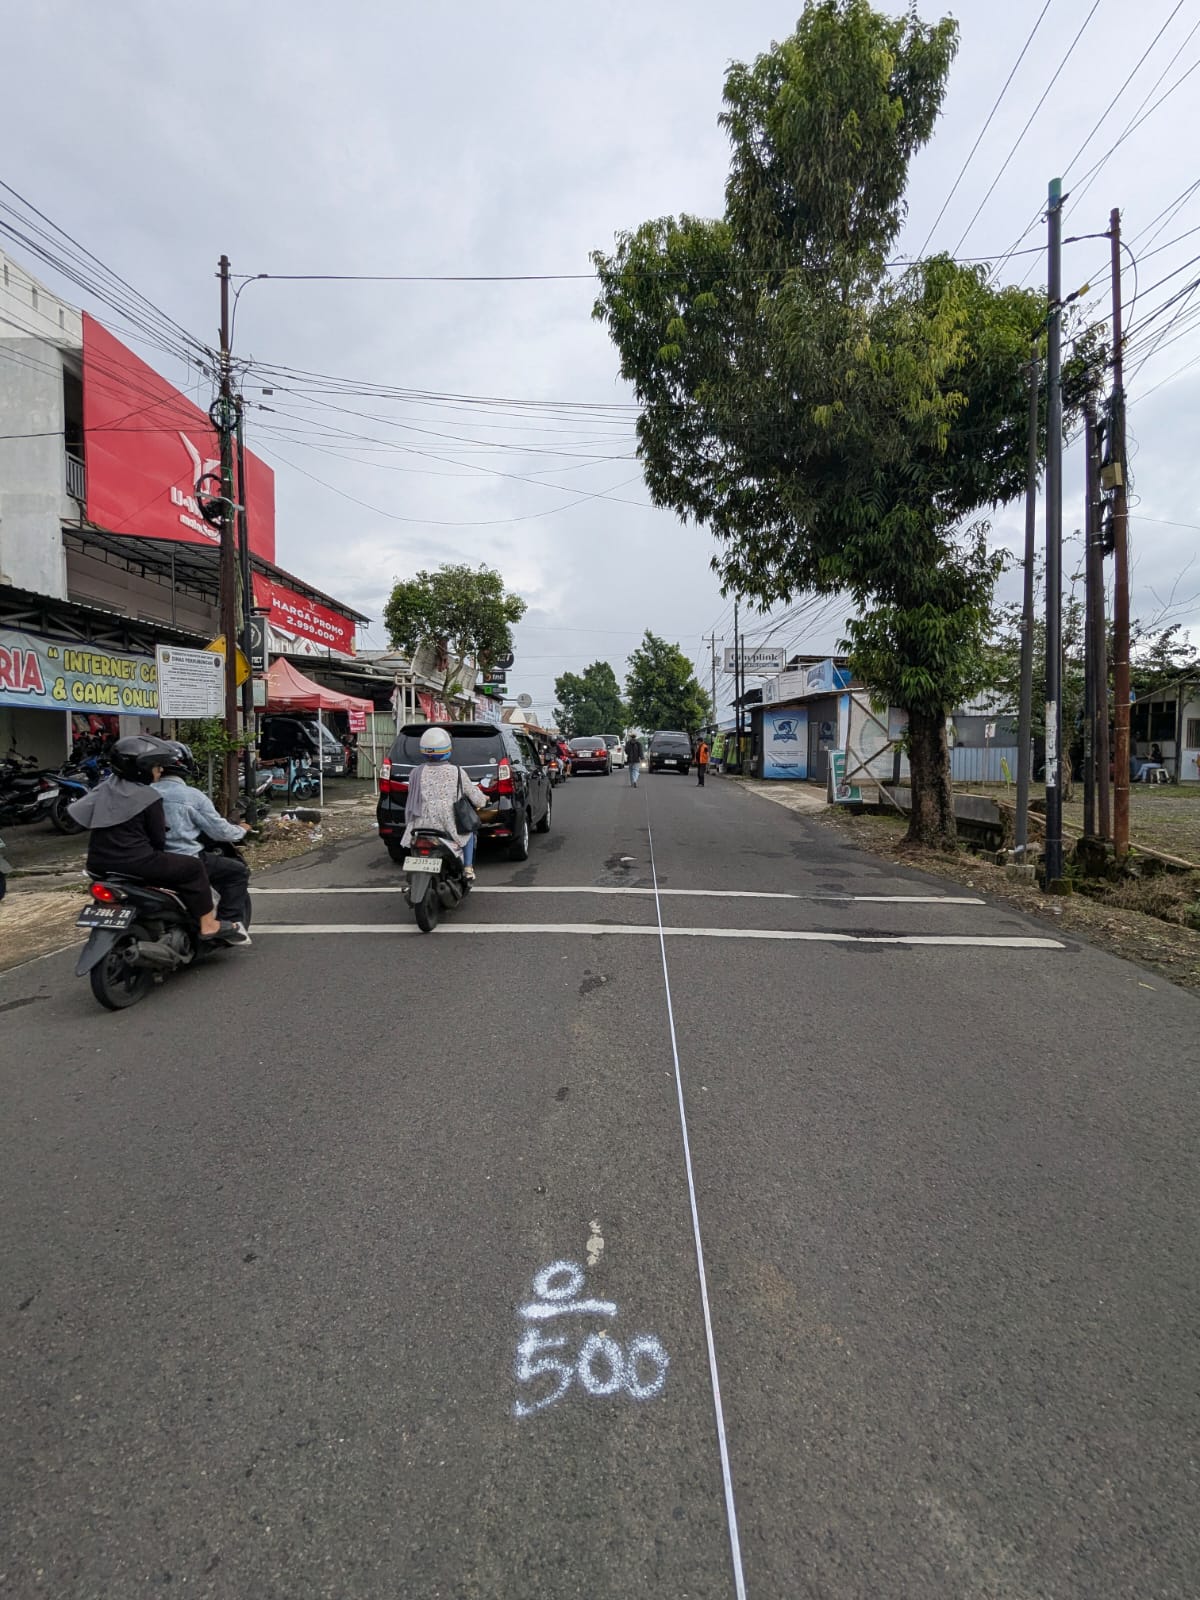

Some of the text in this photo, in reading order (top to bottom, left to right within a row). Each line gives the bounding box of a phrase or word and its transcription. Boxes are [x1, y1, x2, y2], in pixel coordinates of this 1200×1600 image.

[272, 597, 312, 622] HARGA
[313, 616, 344, 636] PROMO
[287, 616, 335, 641] 2.999.000
[64, 649, 137, 681] INTERNET
[52, 677, 67, 701] &
[72, 681, 119, 706] GAME
[533, 1260, 585, 1300] 0
[513, 1327, 671, 1418] 500
